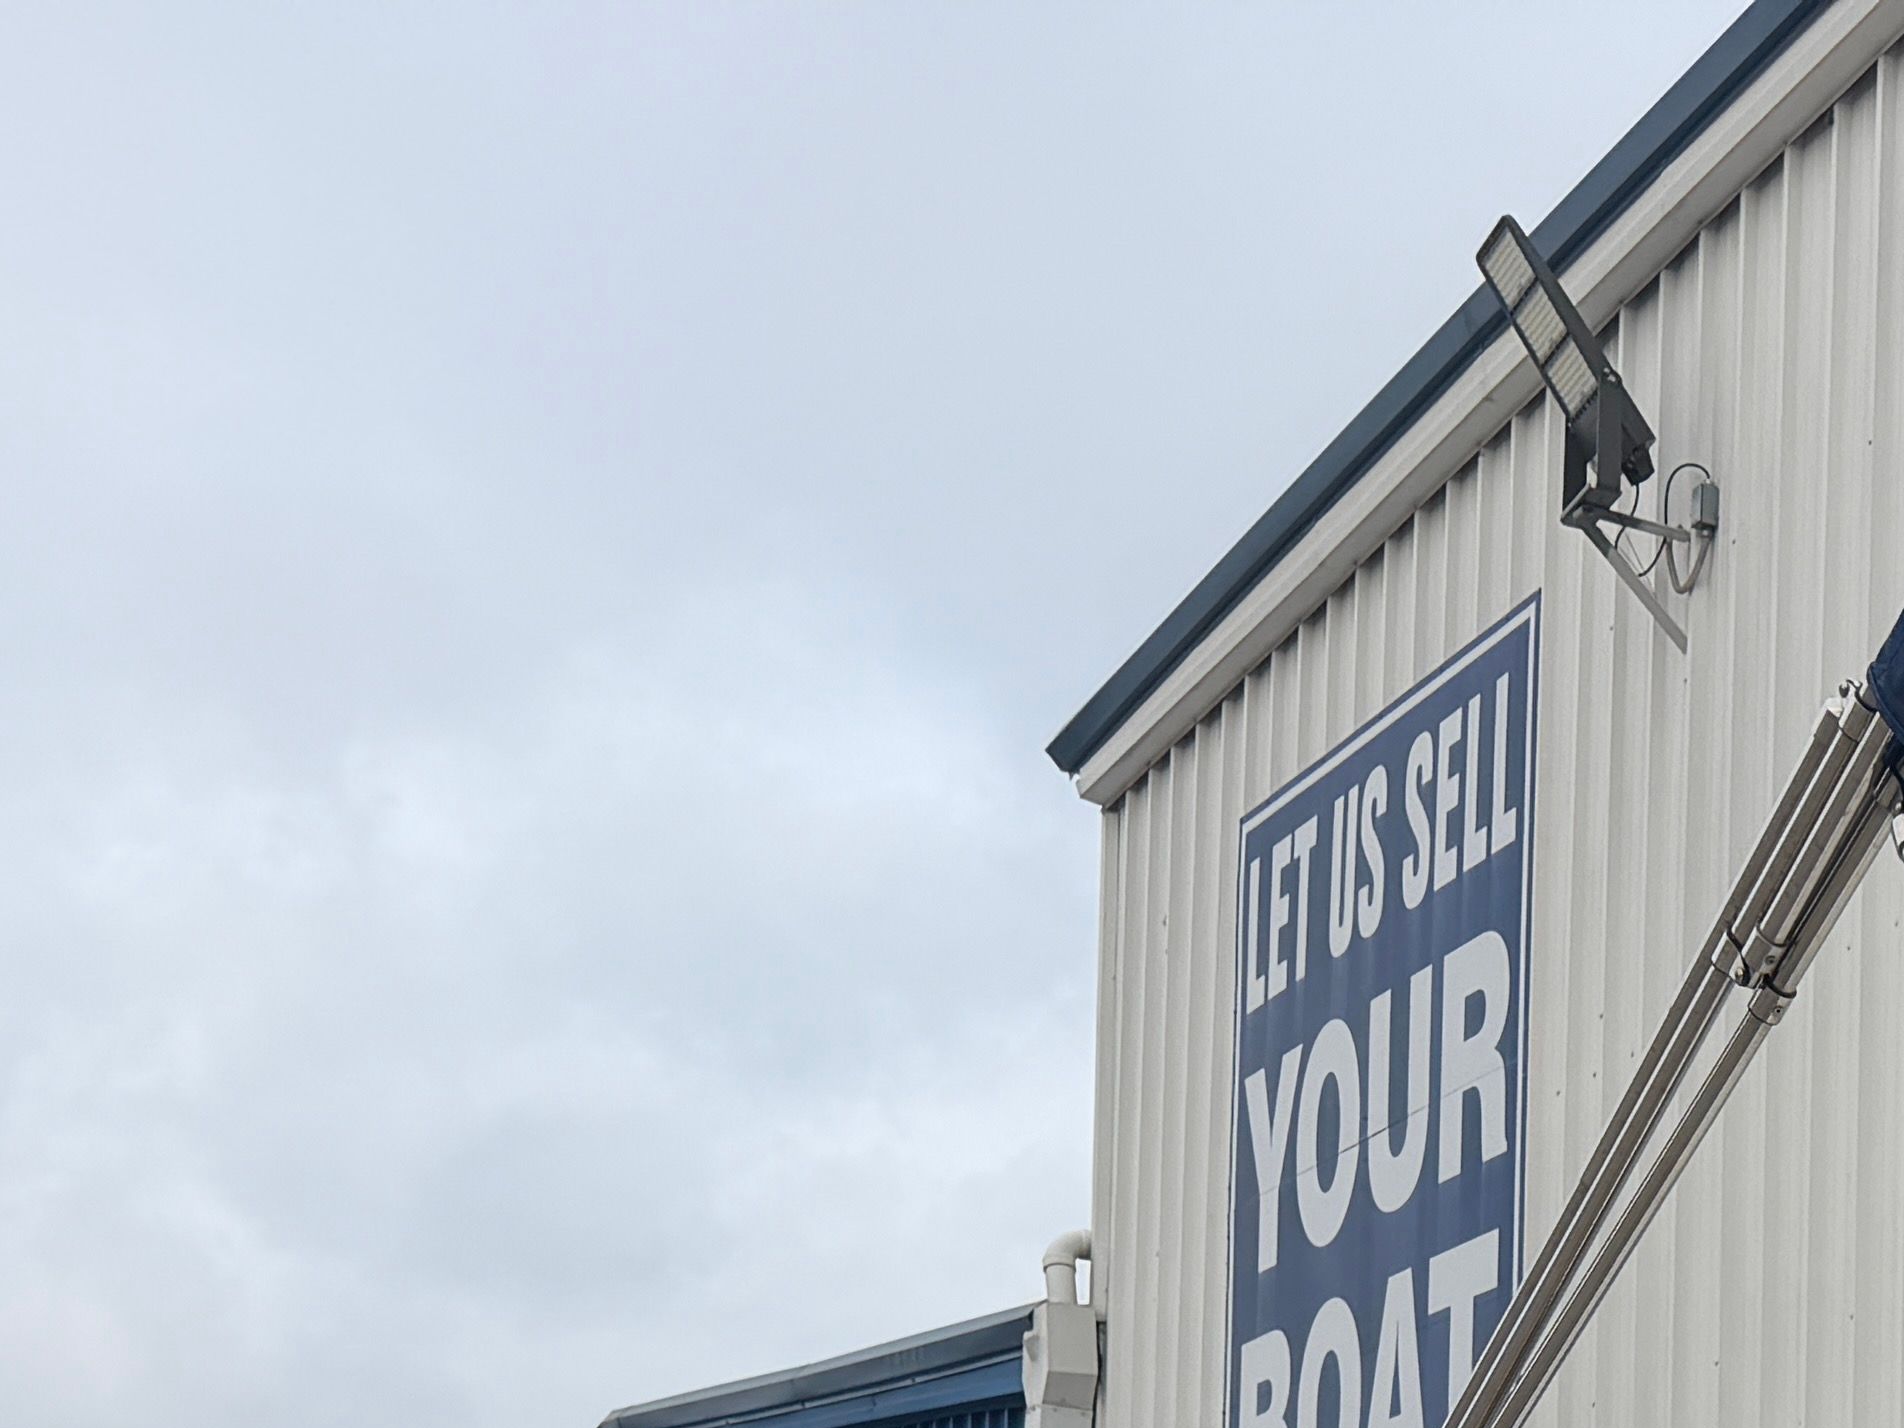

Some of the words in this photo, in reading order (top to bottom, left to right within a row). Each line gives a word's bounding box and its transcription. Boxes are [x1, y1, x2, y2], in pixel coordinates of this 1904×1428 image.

[1246, 814, 1318, 1015] LET
[1329, 764, 1388, 959] US
[1402, 672, 1517, 910] SELL
[1244, 930, 1511, 1274] YOUR
